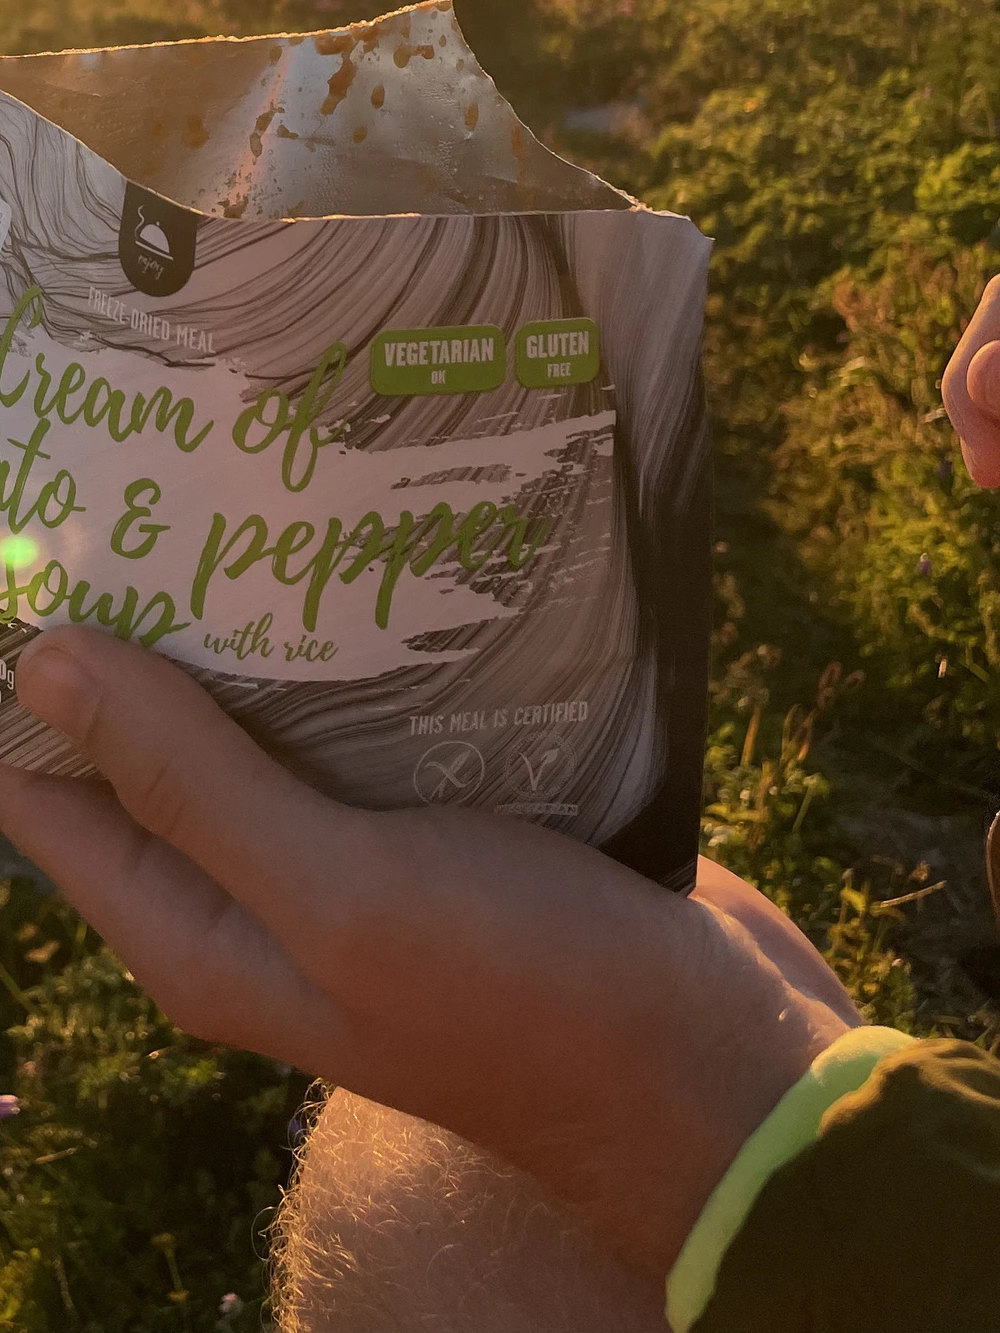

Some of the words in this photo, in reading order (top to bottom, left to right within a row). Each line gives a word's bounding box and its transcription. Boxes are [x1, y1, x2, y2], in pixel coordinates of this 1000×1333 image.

[88, 286, 171, 341] FREEZE-DRIED
[176, 325, 217, 354] MEAL
[384, 337, 495, 367] VEGETARIAN
[526, 330, 590, 359] GLUTEN
[430, 369, 447, 385] OK
[546, 362, 572, 378] FREE
[231, 340, 352, 494] of
[109, 477, 172, 560] &
[190, 499, 550, 632] pepper
[203, 611, 276, 662] with
[282, 632, 340, 663] rice
[409, 714, 444, 736] THIS
[449, 710, 488, 733] MEAL
[493, 708, 508, 729] IS
[513, 700, 589, 726] CERTIFIED
